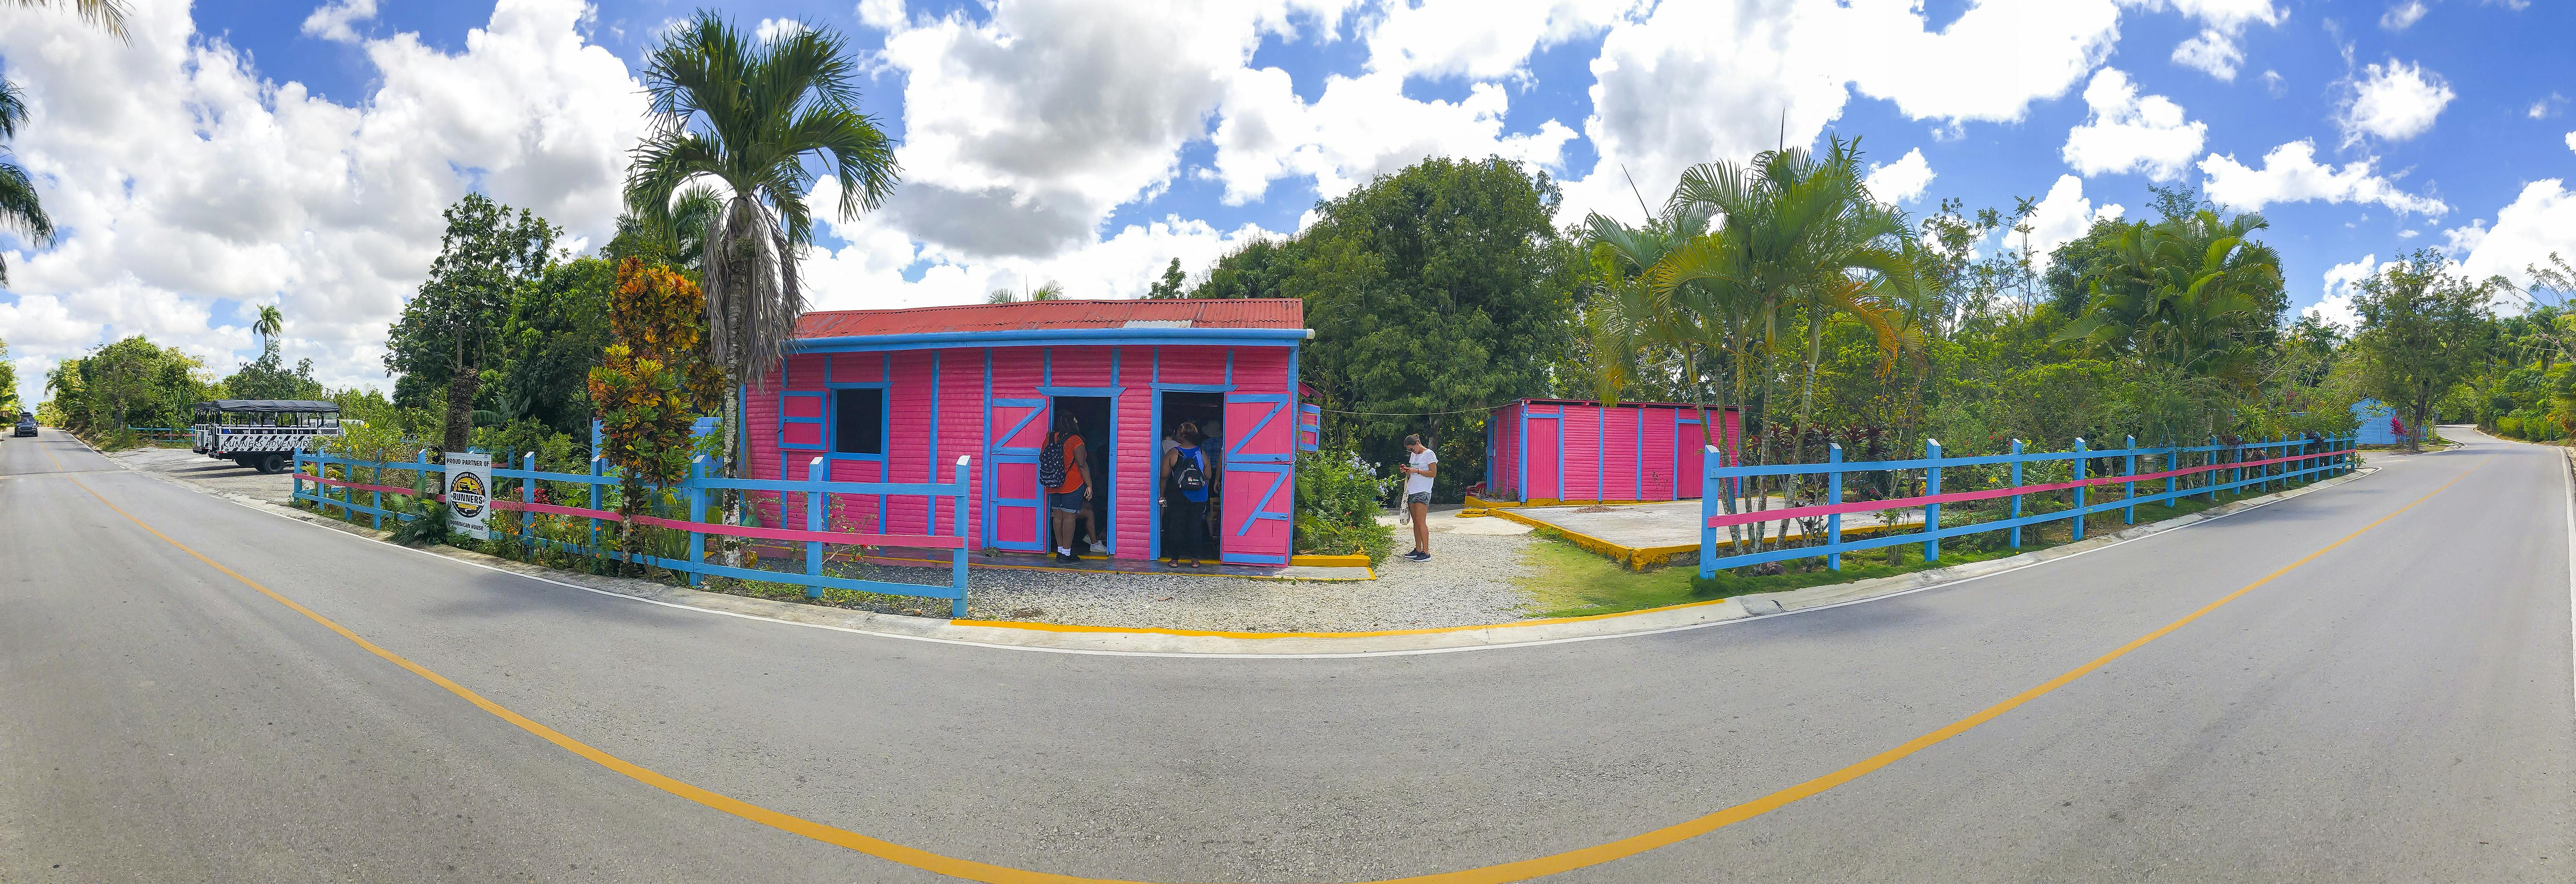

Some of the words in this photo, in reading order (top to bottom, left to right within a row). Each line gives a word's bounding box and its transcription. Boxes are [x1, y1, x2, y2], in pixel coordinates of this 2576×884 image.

[452, 473, 468, 487] DOMINICAN
[470, 473, 484, 491] REPUBLIC
[453, 493, 483, 504] RUNNERS
